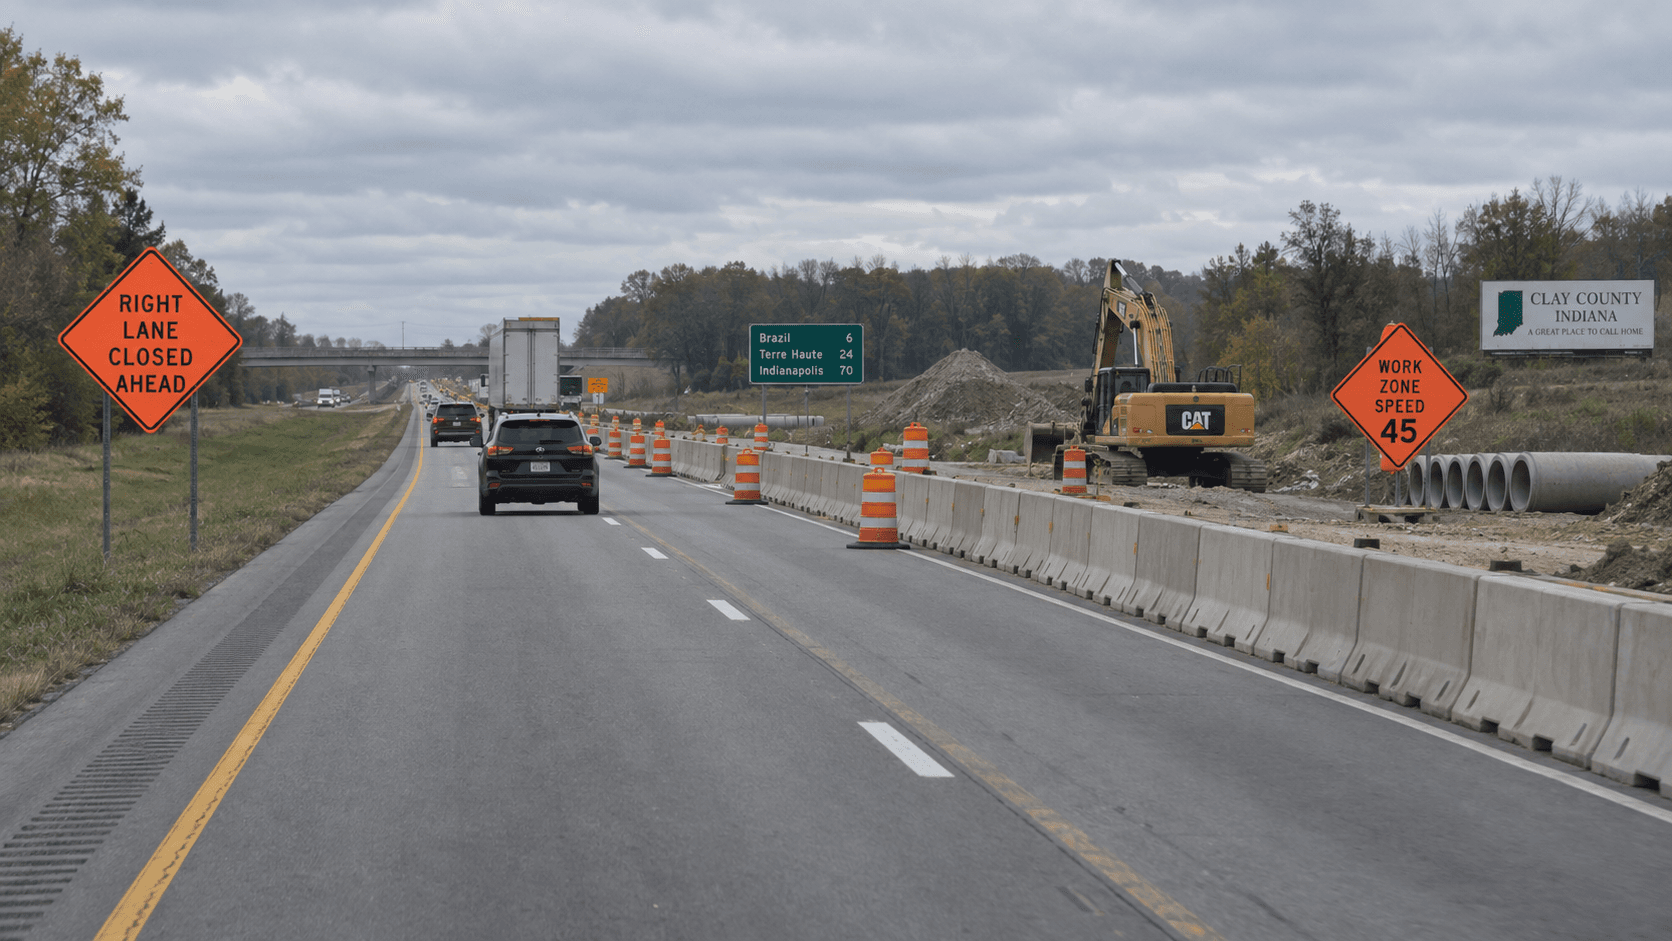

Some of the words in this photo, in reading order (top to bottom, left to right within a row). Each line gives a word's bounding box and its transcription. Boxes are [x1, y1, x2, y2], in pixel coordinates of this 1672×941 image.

[119, 294, 183, 313] RIGHT
[1530, 292, 1571, 305] CLAY
[1576, 291, 1643, 305] COUNTY
[1555, 310, 1618, 322] INDIANA
[123, 321, 178, 340] LANE
[759, 332, 791, 343] Brazil
[846, 332, 853, 343] 6
[109, 347, 192, 366] CLOSED
[759, 349, 787, 360] Terre
[791, 349, 823, 360] Haute
[839, 349, 854, 360] 24
[760, 365, 823, 377] Indianapolis
[840, 365, 853, 375] 70
[1378, 359, 1422, 374] WORK
[115, 375, 186, 393] AHEAD
[1380, 379, 1421, 394] ZONE
[1375, 399, 1425, 414] SPEED
[1182, 411, 1211, 430] CAT
[1380, 419, 1417, 444] 45
